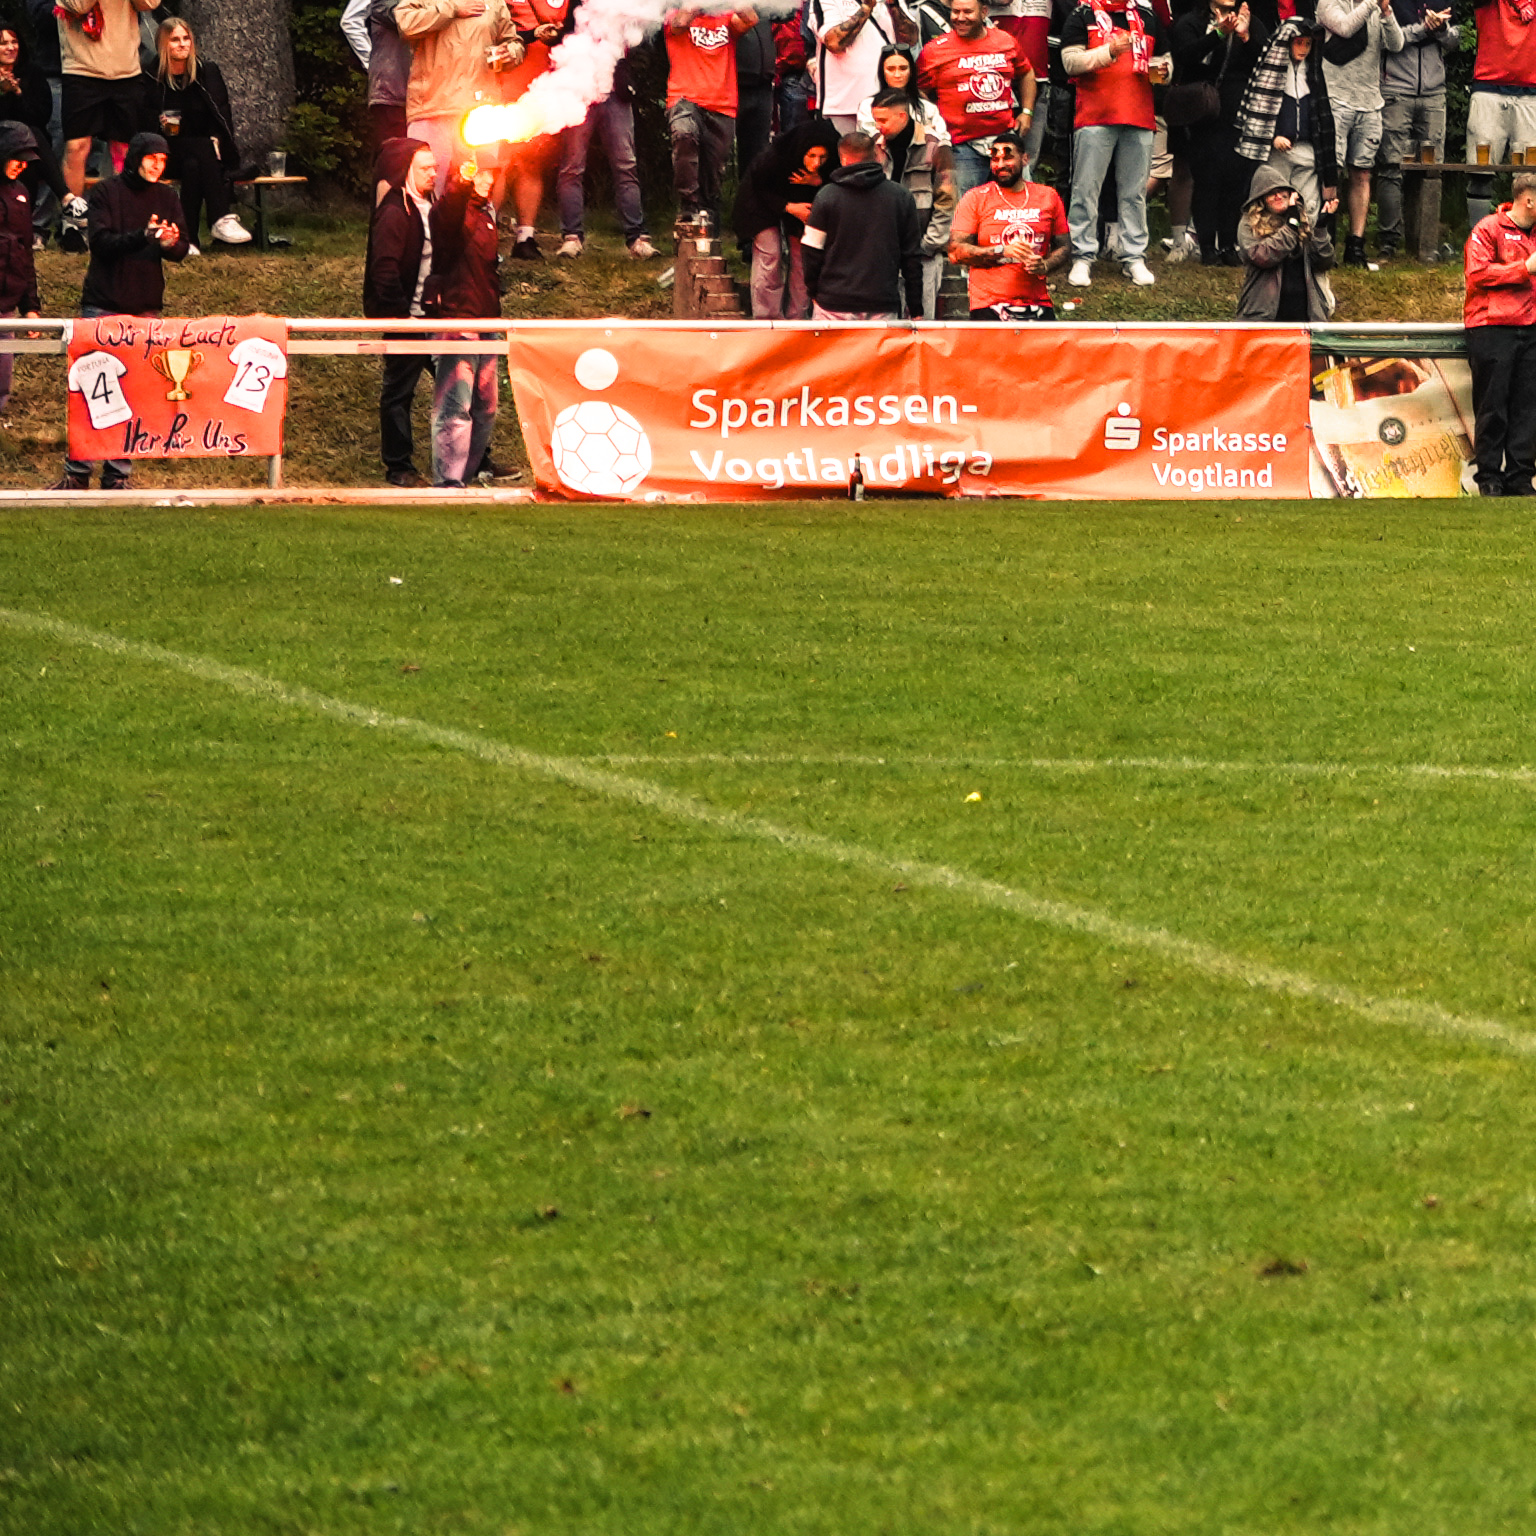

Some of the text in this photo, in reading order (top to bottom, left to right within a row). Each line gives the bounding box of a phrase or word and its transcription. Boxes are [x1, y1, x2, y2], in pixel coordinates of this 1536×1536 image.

[95, 320, 140, 347] Wir
[179, 317, 236, 348] Euch
[91, 372, 114, 404] 4
[236, 361, 270, 392] 13
[690, 386, 978, 438] Sparkassen-
[203, 420, 246, 454] Uns
[1152, 426, 1287, 456] Sparkasse
[690, 444, 993, 489] Vogtlandliga
[1152, 463, 1273, 492] Vogtland
